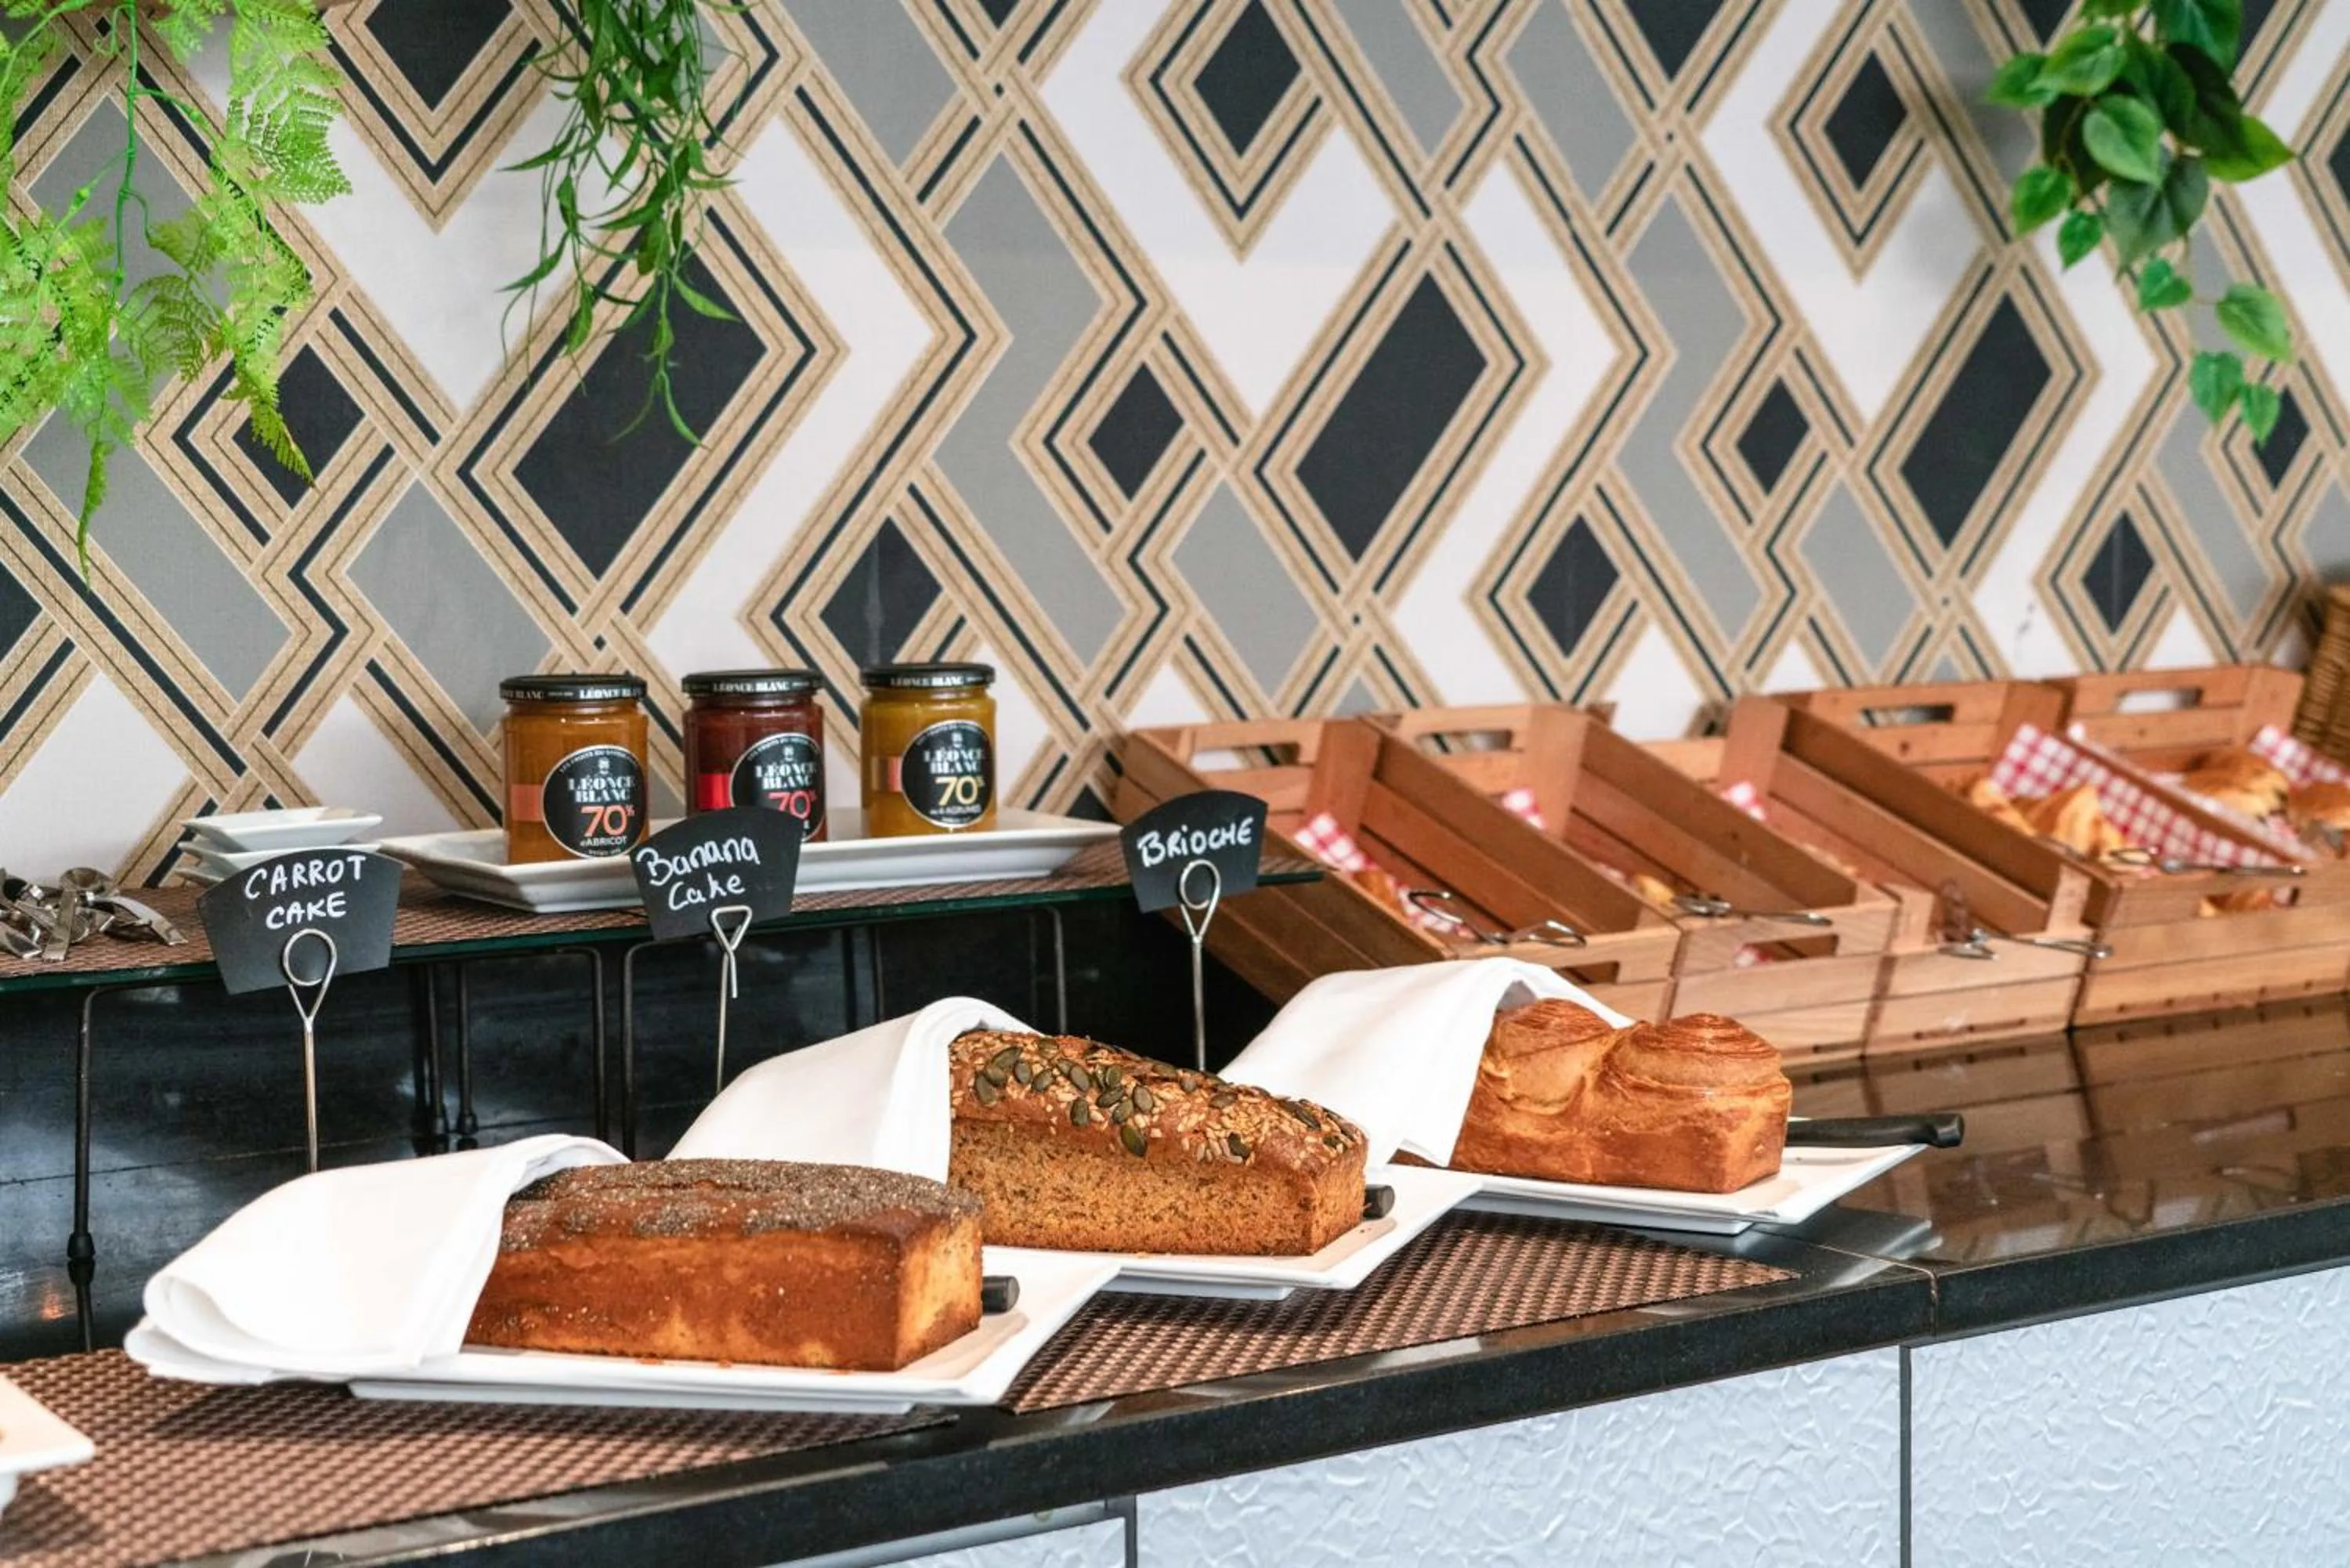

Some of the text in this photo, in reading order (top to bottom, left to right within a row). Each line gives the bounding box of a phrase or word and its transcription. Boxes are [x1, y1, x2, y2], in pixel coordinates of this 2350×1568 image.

[574, 788, 631, 804] BLANC
[244, 854, 367, 900] CARROT
[636, 837, 761, 886] Banana
[265, 891, 348, 930] CAKE
[668, 873, 746, 911] Cake
